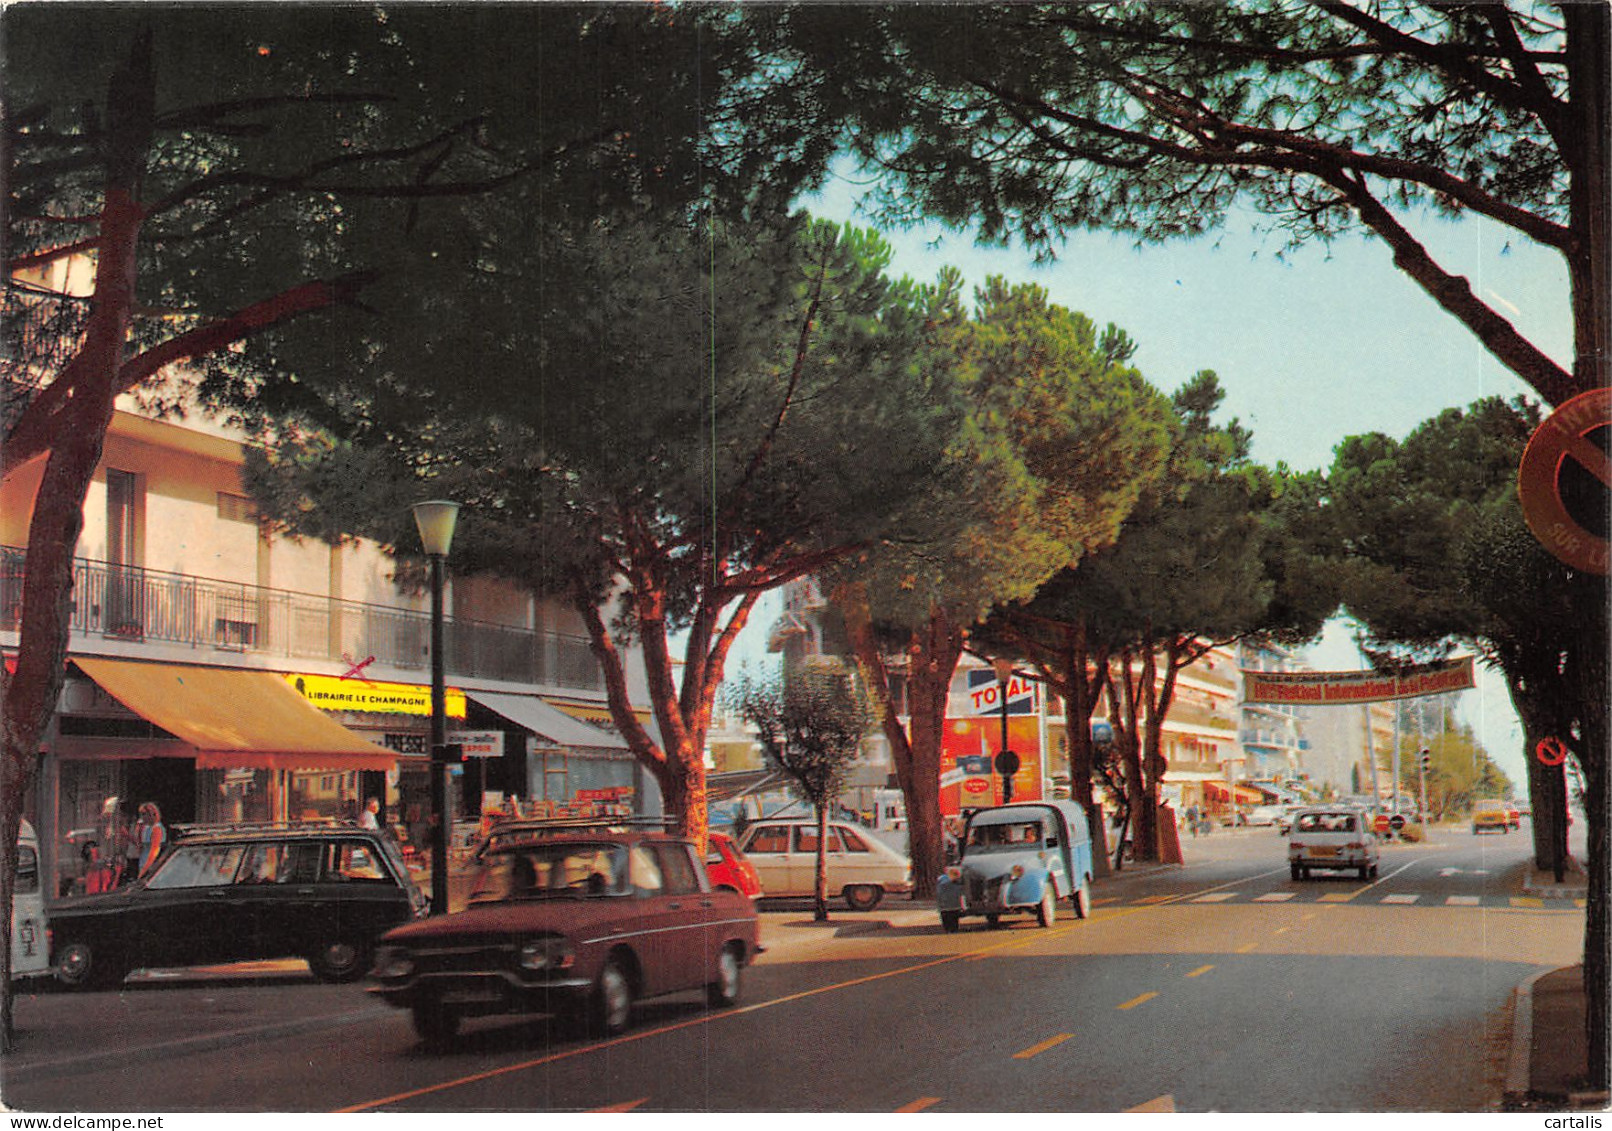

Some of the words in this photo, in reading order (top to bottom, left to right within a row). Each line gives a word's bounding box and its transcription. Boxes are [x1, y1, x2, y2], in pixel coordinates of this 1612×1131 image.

[1550, 522, 1582, 554] SUR
[308, 691, 353, 702] LIBRAIRIE
[356, 695, 366, 703] LE
[369, 695, 426, 706] CHAMPAGNE
[970, 677, 1032, 709] TOAL
